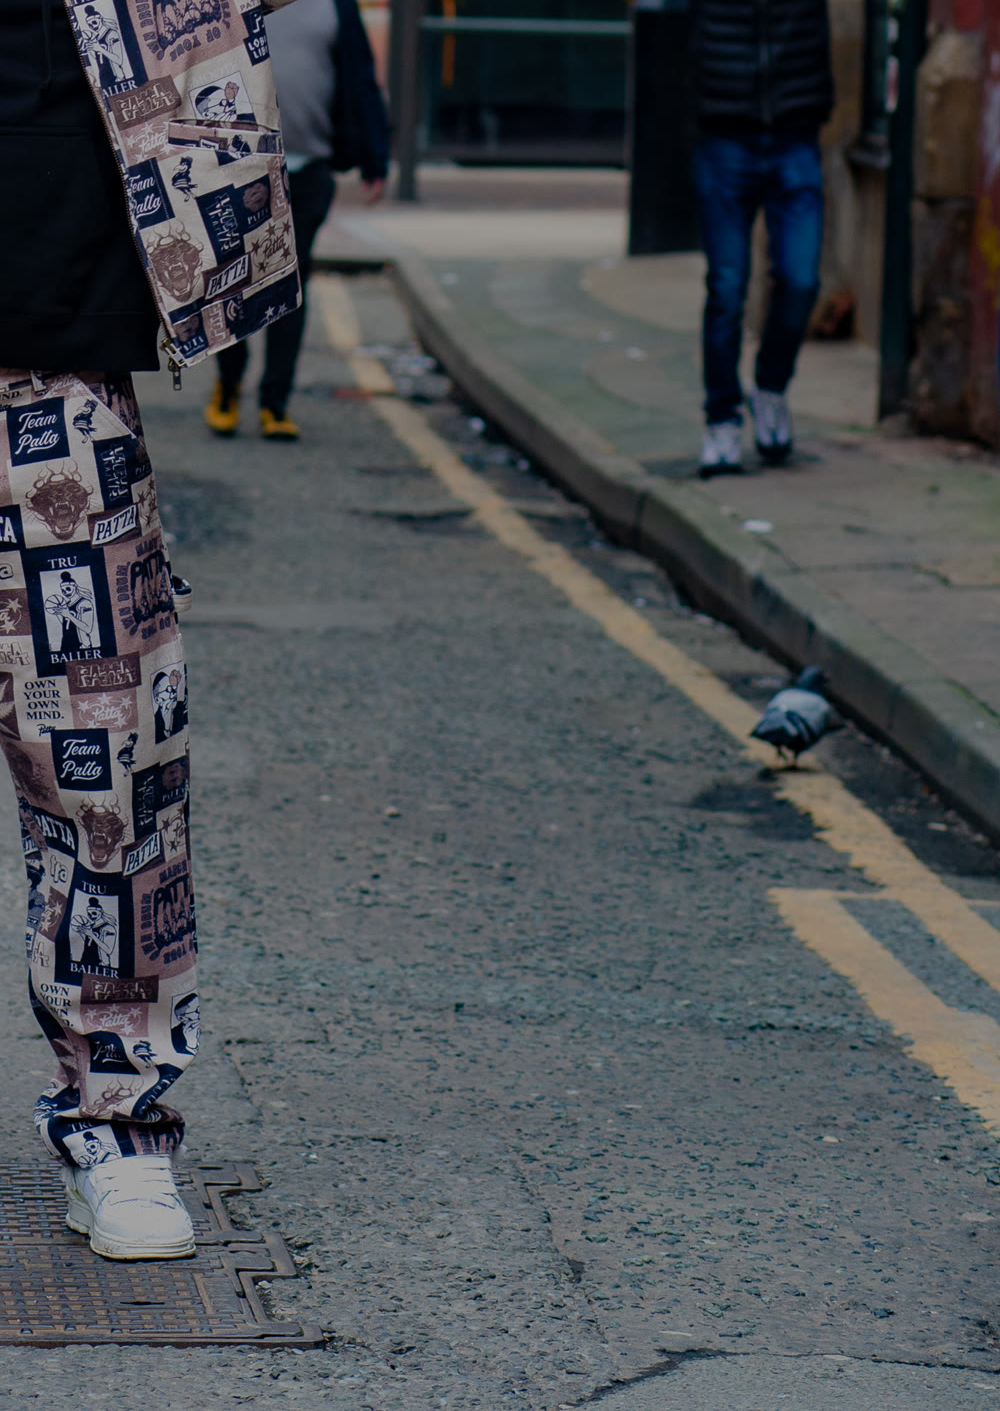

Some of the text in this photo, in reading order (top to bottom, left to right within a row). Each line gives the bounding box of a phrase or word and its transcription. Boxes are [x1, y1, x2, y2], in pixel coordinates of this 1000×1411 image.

[239, 0, 260, 11] PATT
[103, 79, 138, 98] ALLER
[208, 259, 247, 296] PATTA
[18, 410, 58, 435] Team
[14, 430, 60, 455] Patta
[96, 507, 136, 541] PATTA
[48, 556, 78, 569] TRU
[50, 649, 103, 664] BALLER
[24, 679, 56, 690] OWN
[23, 689, 61, 700] YOUR
[27, 700, 60, 710] OWN
[92, 704, 122, 721] Patta
[26, 710, 65, 720] MIND.
[62, 738, 102, 760] Team
[60, 759, 103, 781] Patta
[126, 835, 161, 872] PATTA
[81, 880, 107, 895] TRU
[70, 961, 119, 979] BALLER
[40, 984, 70, 996] OWN
[99, 1011, 130, 1027] Patta
